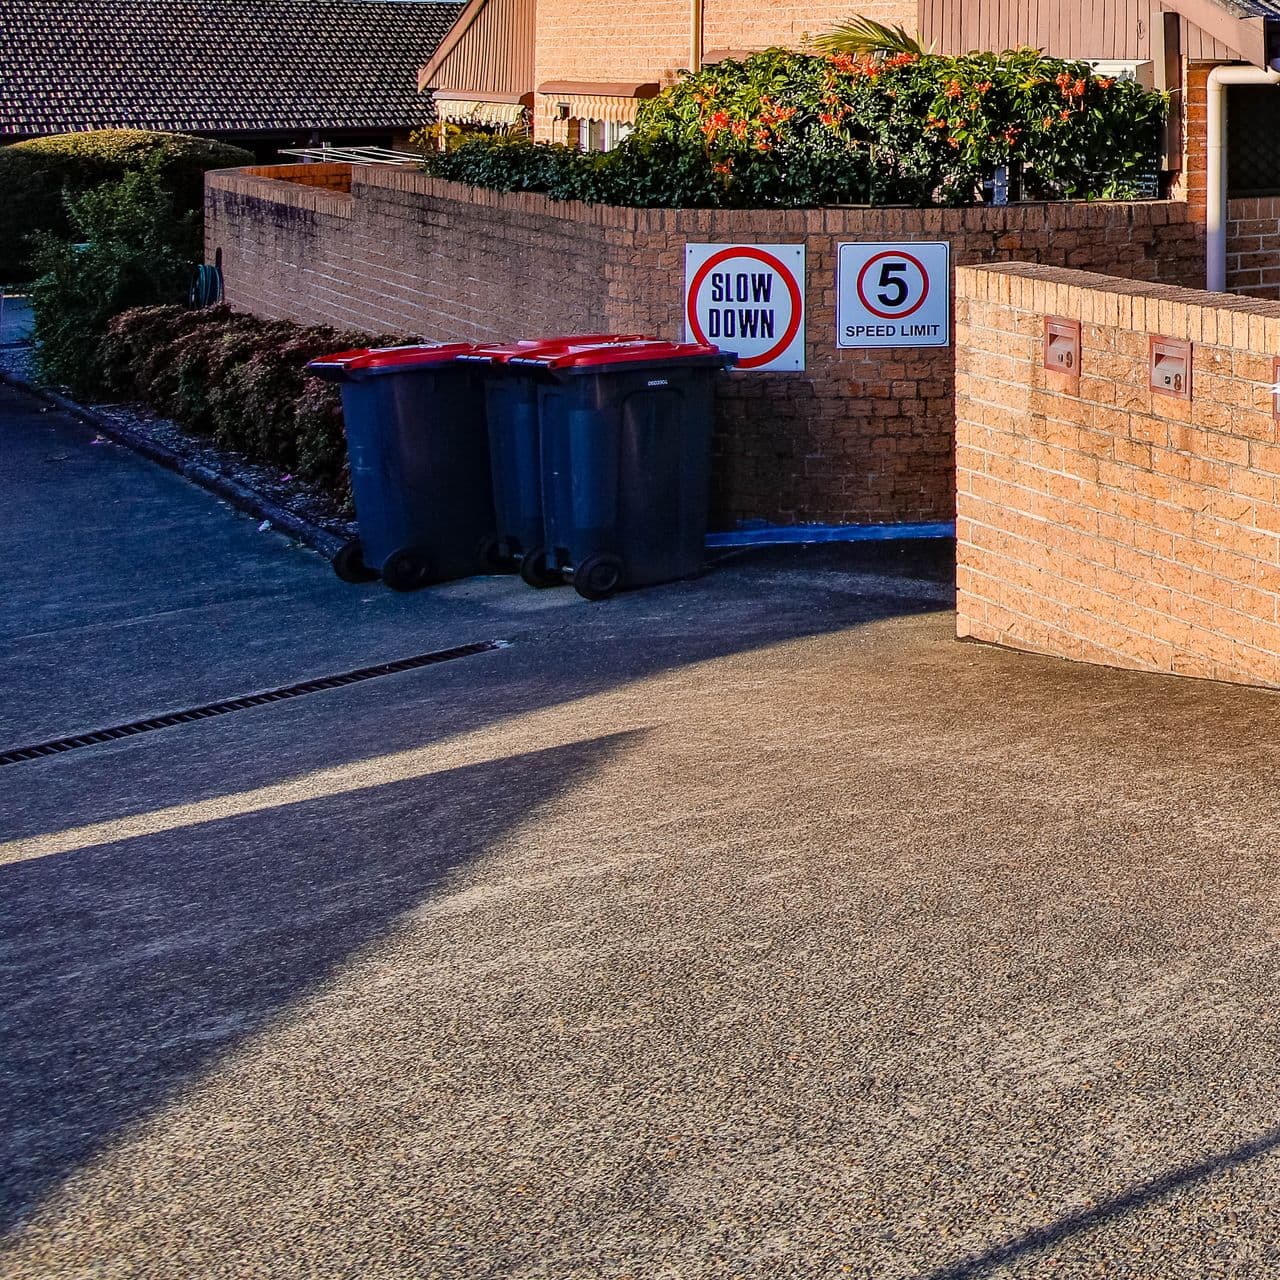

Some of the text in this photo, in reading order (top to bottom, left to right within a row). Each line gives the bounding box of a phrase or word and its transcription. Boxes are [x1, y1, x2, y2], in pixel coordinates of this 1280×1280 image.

[711, 273, 773, 303] SLOW
[877, 263, 908, 307] 5
[708, 309, 775, 339] DOWN
[846, 324, 940, 337] SPEED LIMIT
[1066, 351, 1073, 368] 9
[1174, 373, 1182, 391] 8
